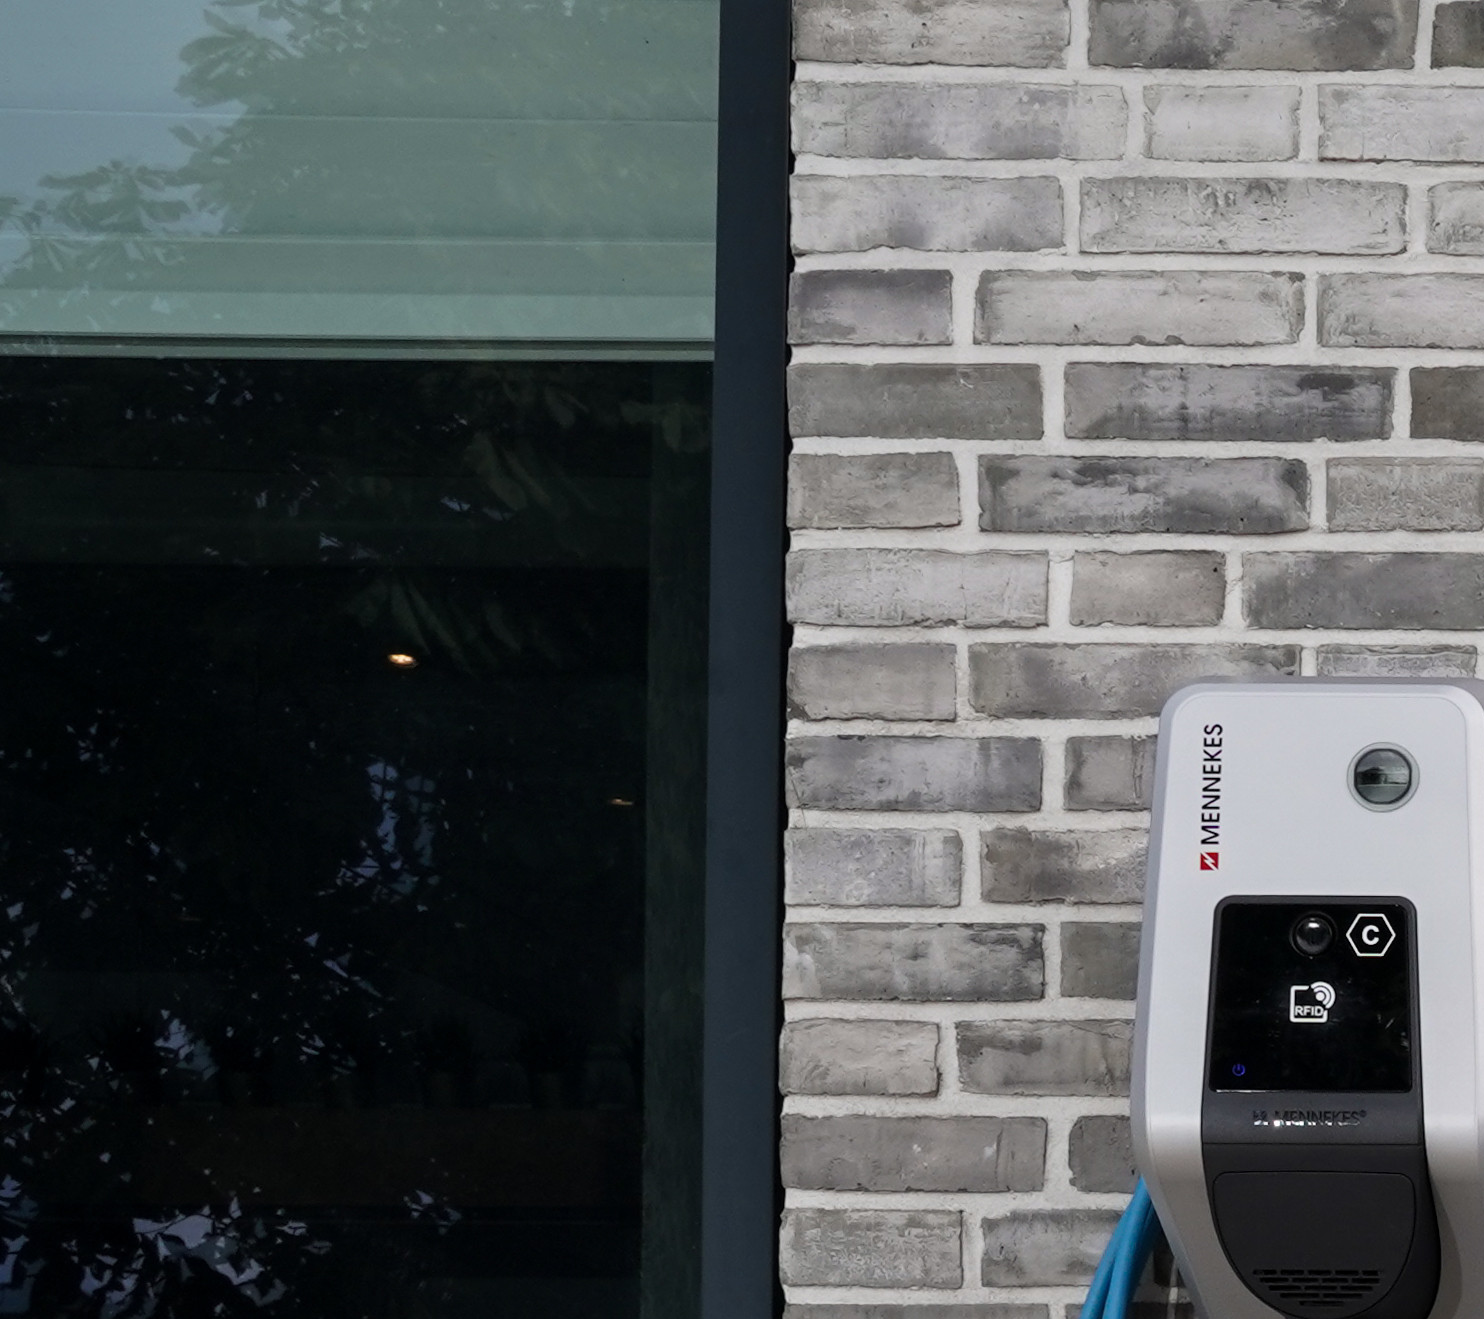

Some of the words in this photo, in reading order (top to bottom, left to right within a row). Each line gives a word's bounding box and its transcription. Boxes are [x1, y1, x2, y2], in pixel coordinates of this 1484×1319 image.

[1201, 724, 1223, 844] MENNEKES
[1361, 925, 1380, 945] C
[1294, 1005, 1325, 1017] RFID
